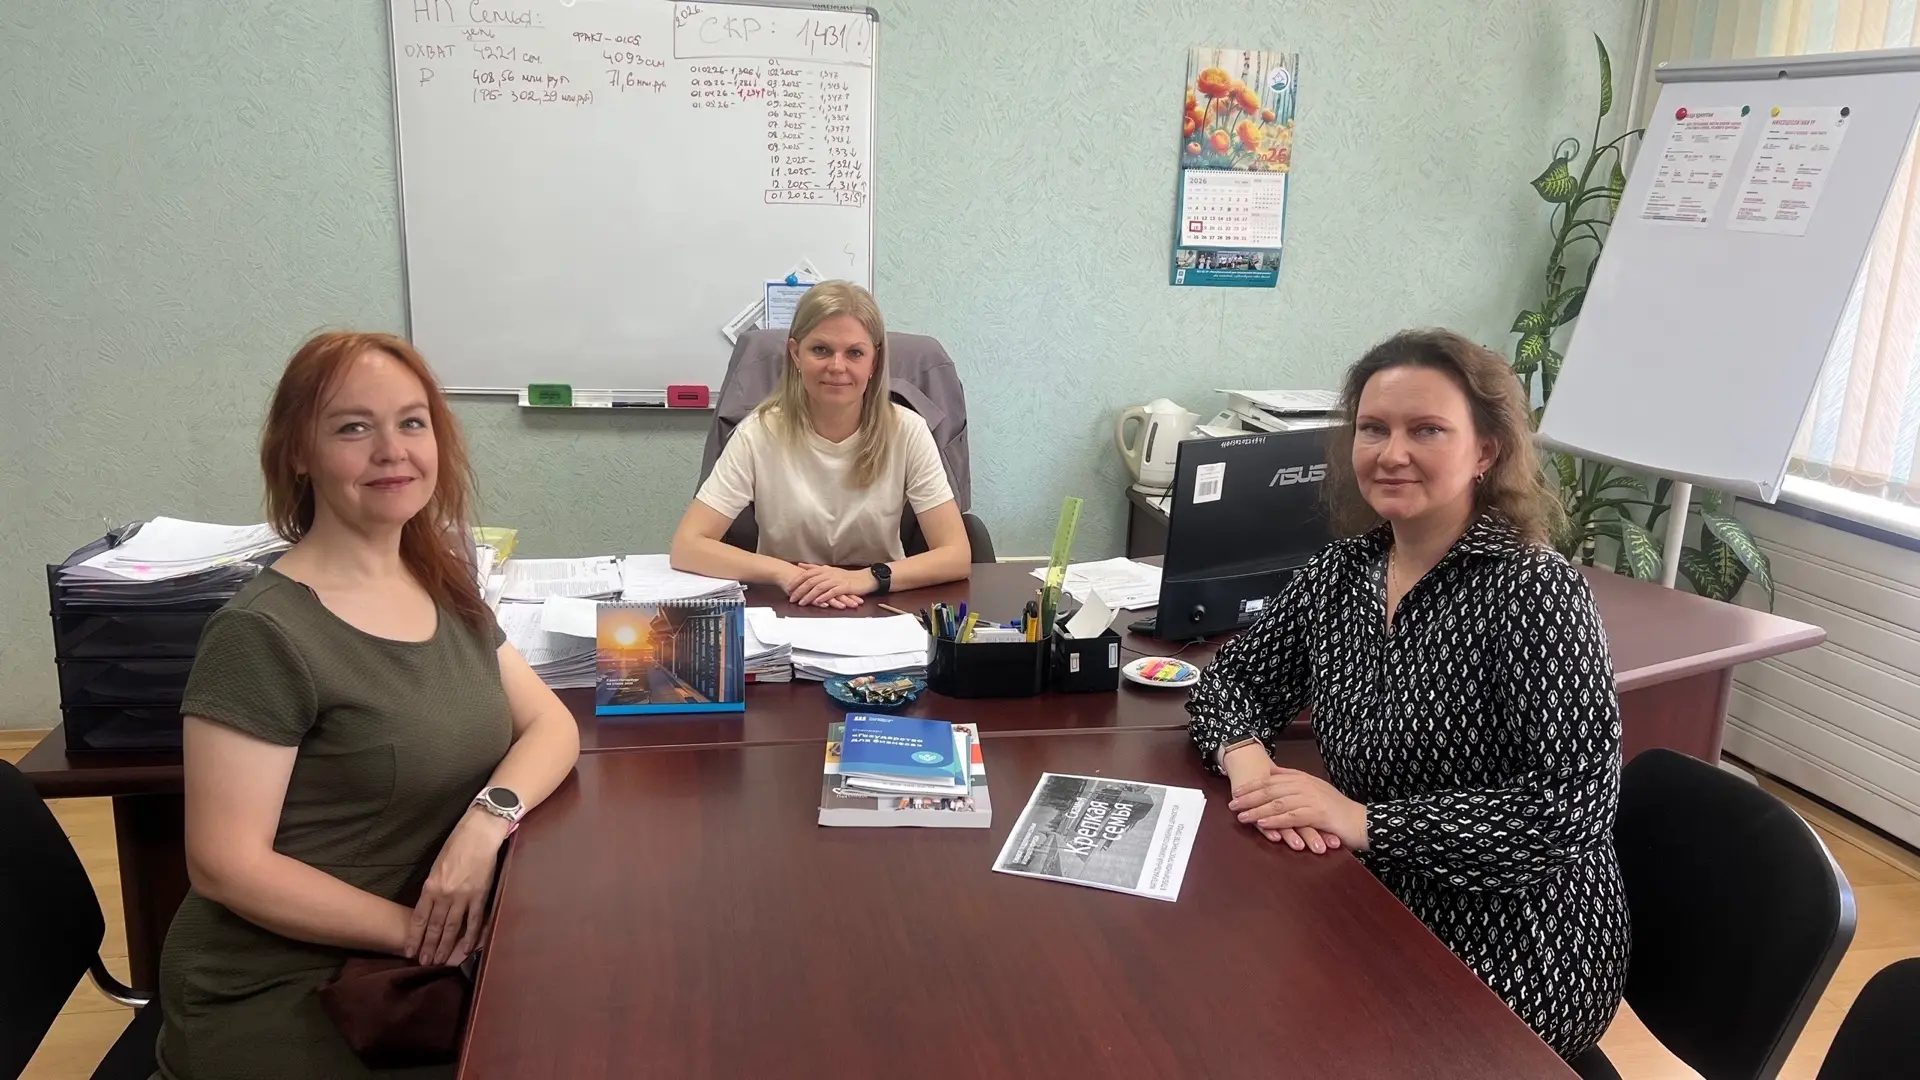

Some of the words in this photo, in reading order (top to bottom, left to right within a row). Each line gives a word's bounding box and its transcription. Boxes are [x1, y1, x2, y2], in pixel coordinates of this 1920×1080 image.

[404, 43, 457, 60] ОХВАТ
[473, 43, 516, 61] 4221
[1189, 177, 1208, 185] 2026
[1268, 463, 1328, 487] ASUS
[1063, 799, 1110, 856] Крепкая
[1103, 802, 1134, 841] семья
